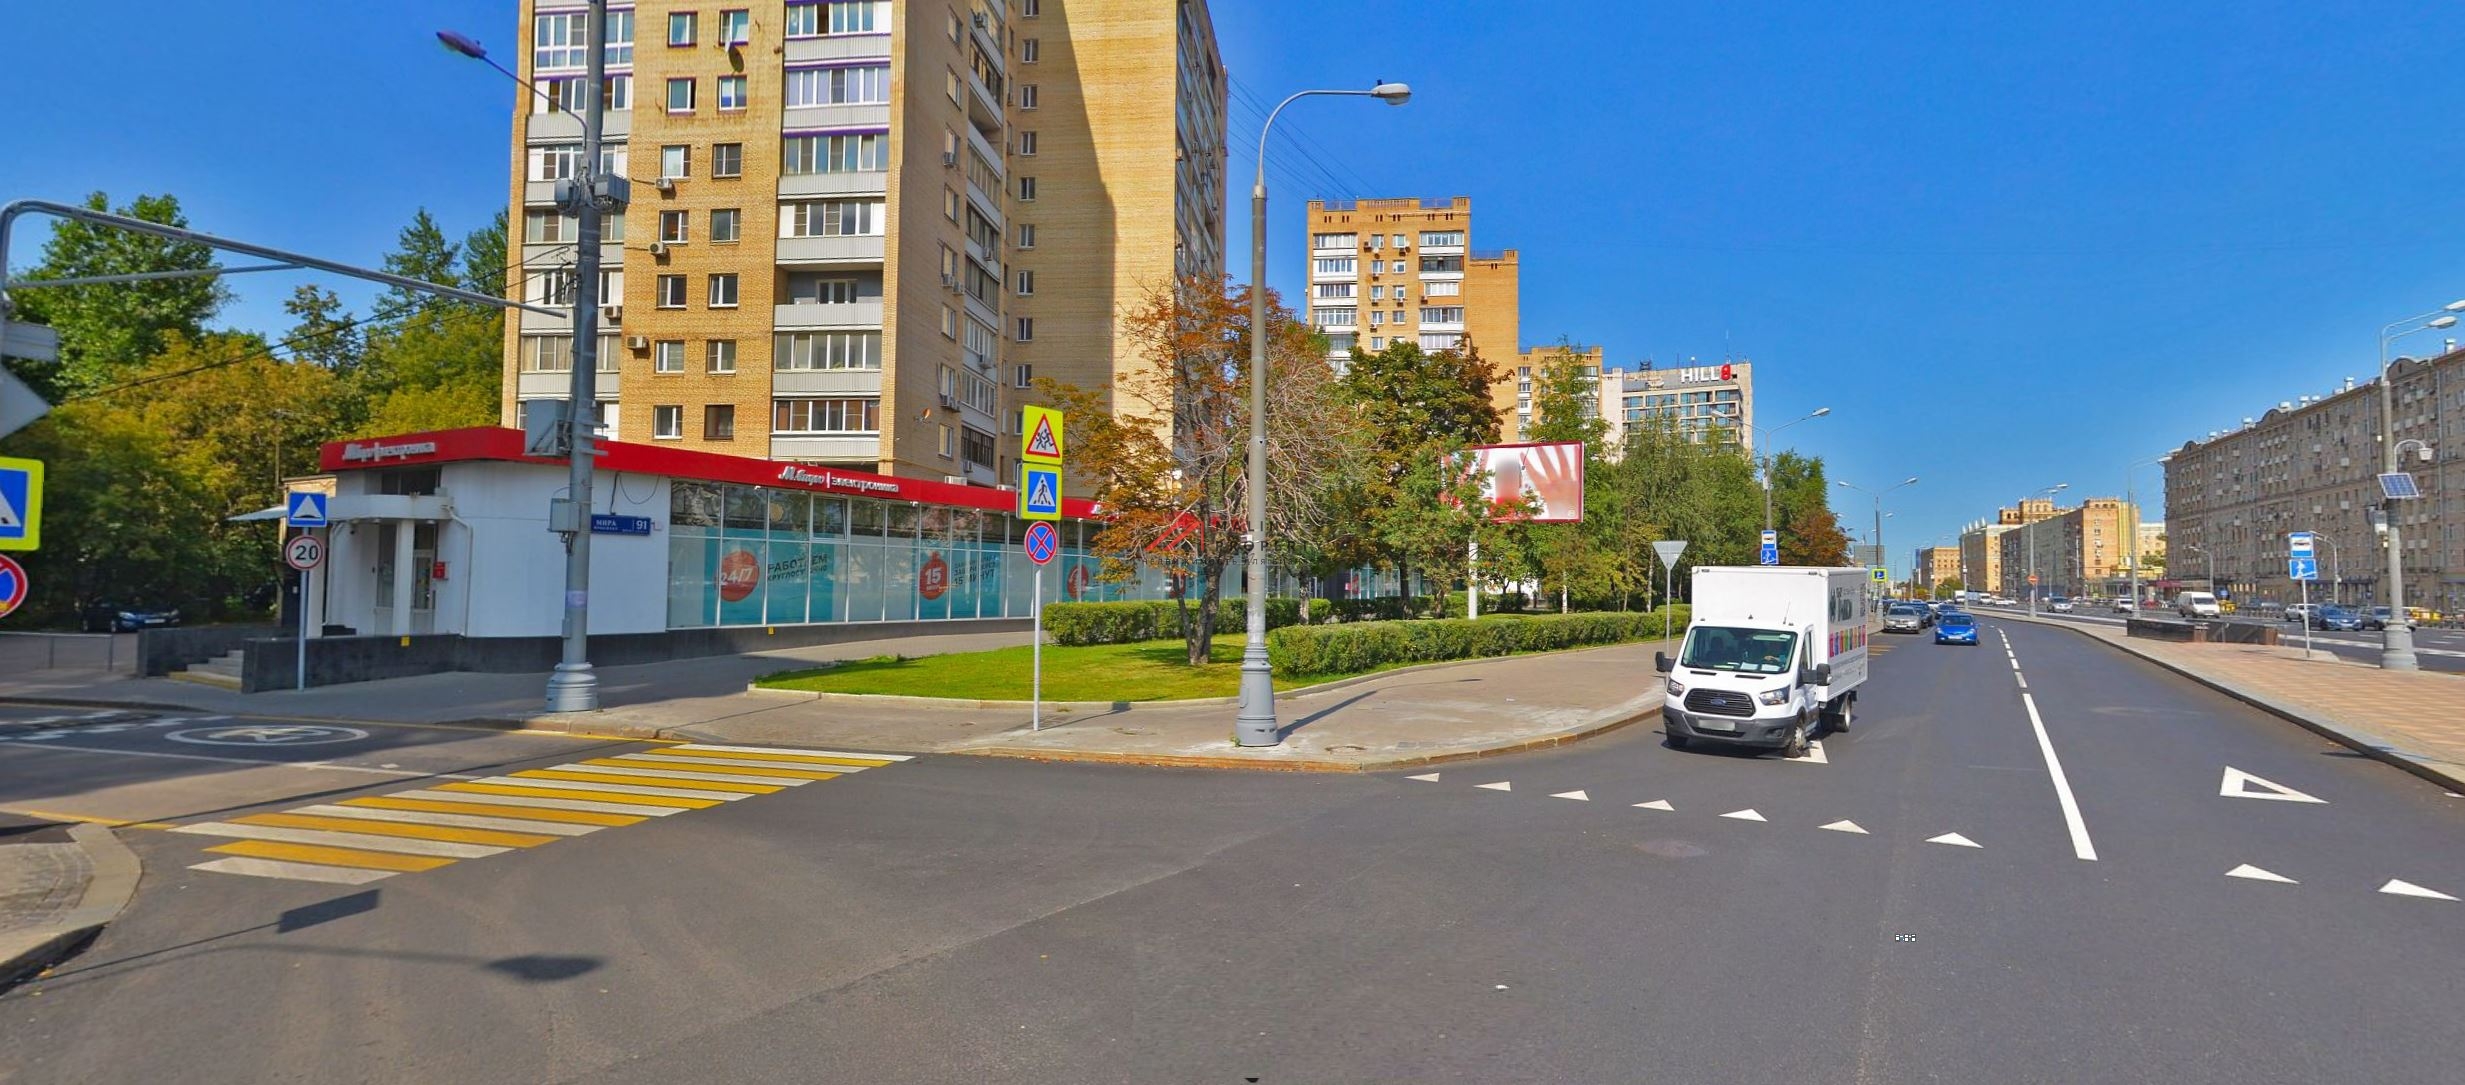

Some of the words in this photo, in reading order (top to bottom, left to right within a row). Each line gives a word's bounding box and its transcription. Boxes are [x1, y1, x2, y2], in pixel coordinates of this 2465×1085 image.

[596, 519, 617, 527] МИРА
[636, 520, 648, 530] 91
[295, 545, 319, 561] 20
[720, 567, 754, 586] 24/7
[925, 567, 942, 585] 15
